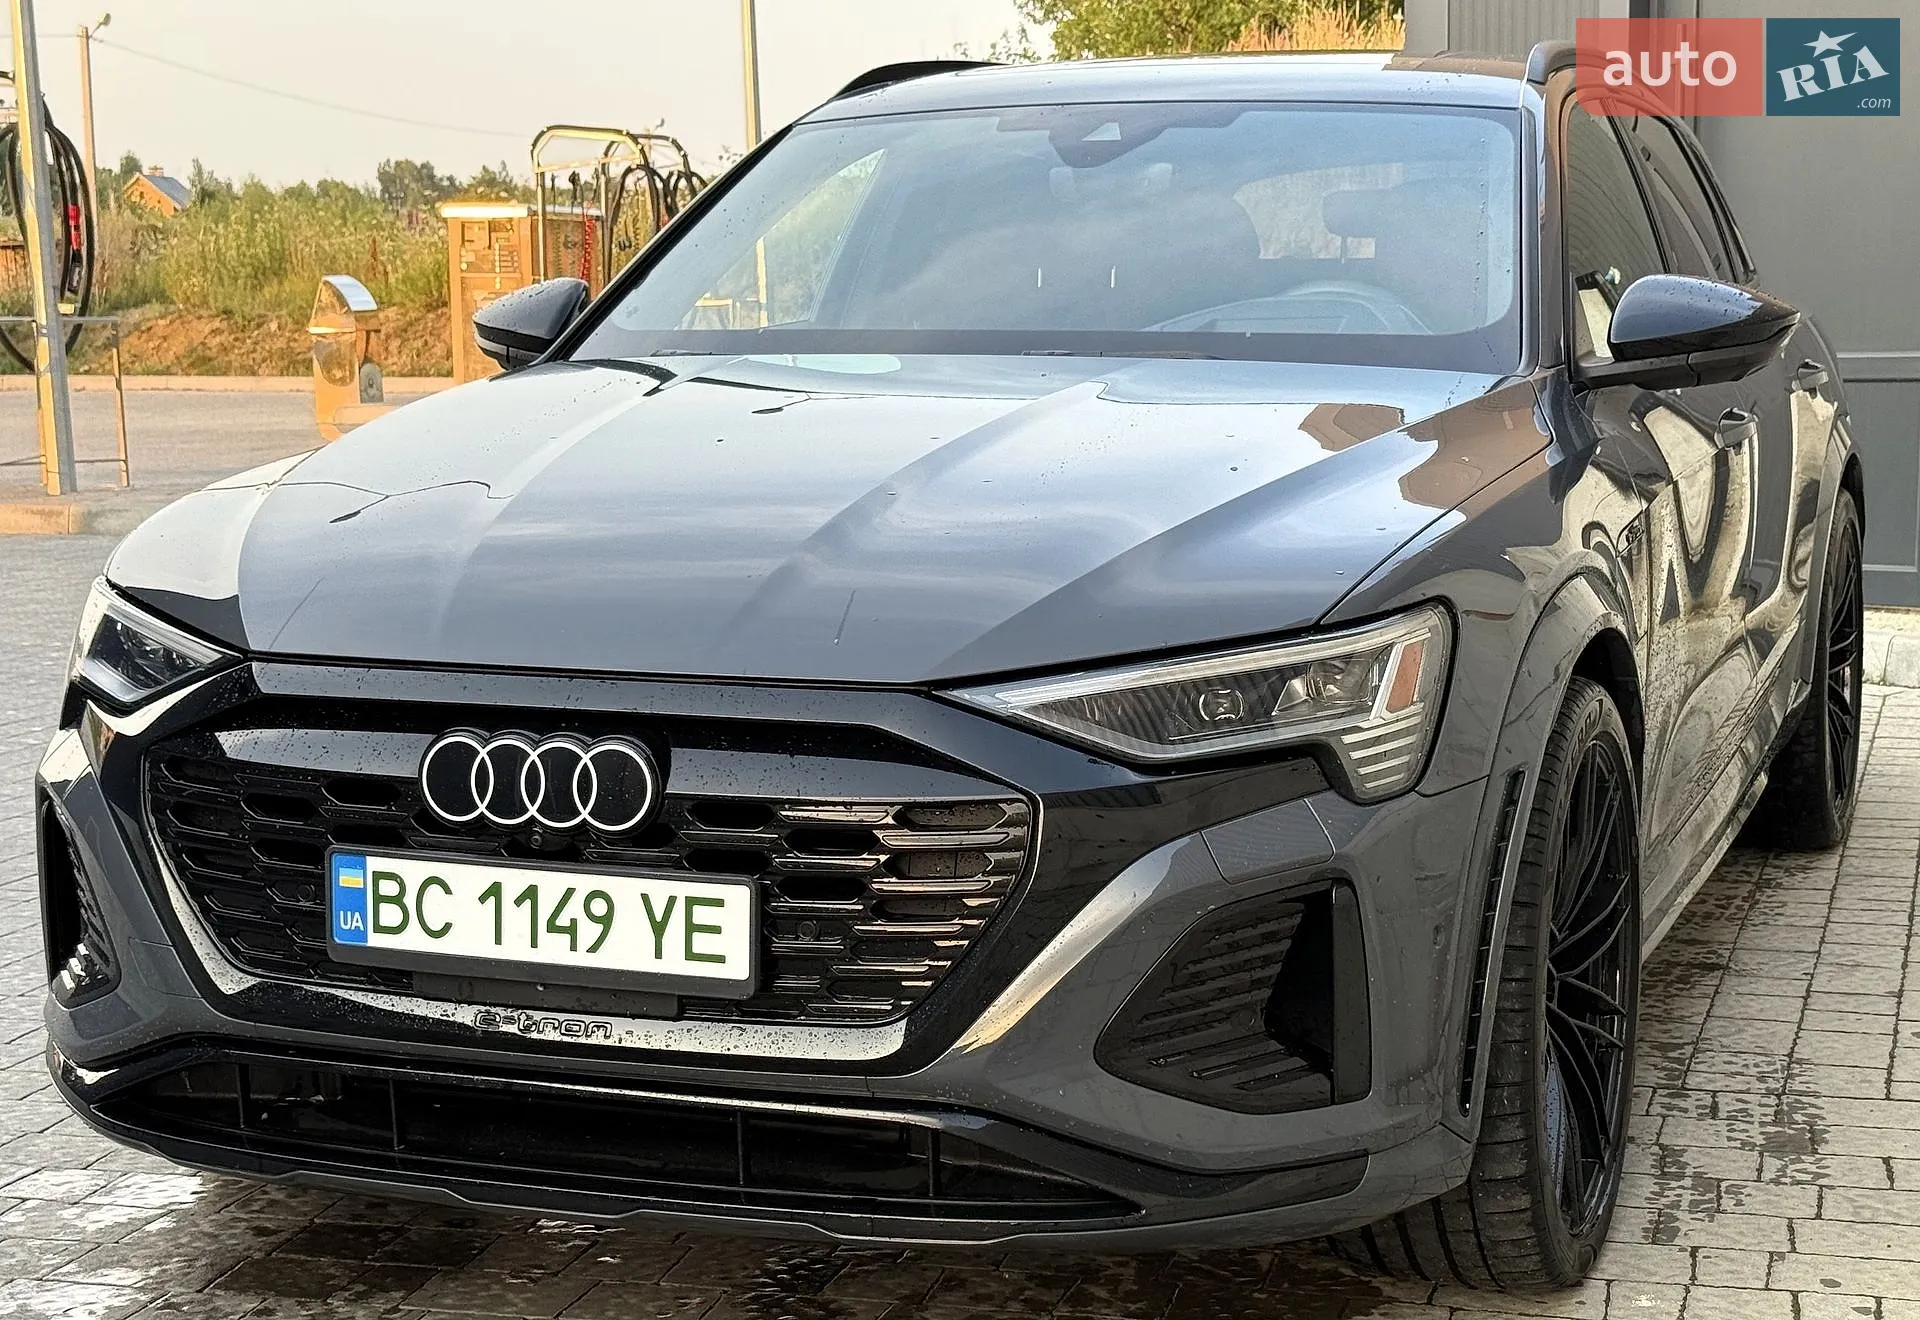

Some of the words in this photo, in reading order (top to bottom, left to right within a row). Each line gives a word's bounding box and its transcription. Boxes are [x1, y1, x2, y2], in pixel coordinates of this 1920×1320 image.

[339, 911, 364, 931] UA
[372, 870, 454, 939] BC
[478, 881, 615, 954] 1149
[640, 893, 727, 964] YE
[474, 1011, 612, 1039] e-tron
